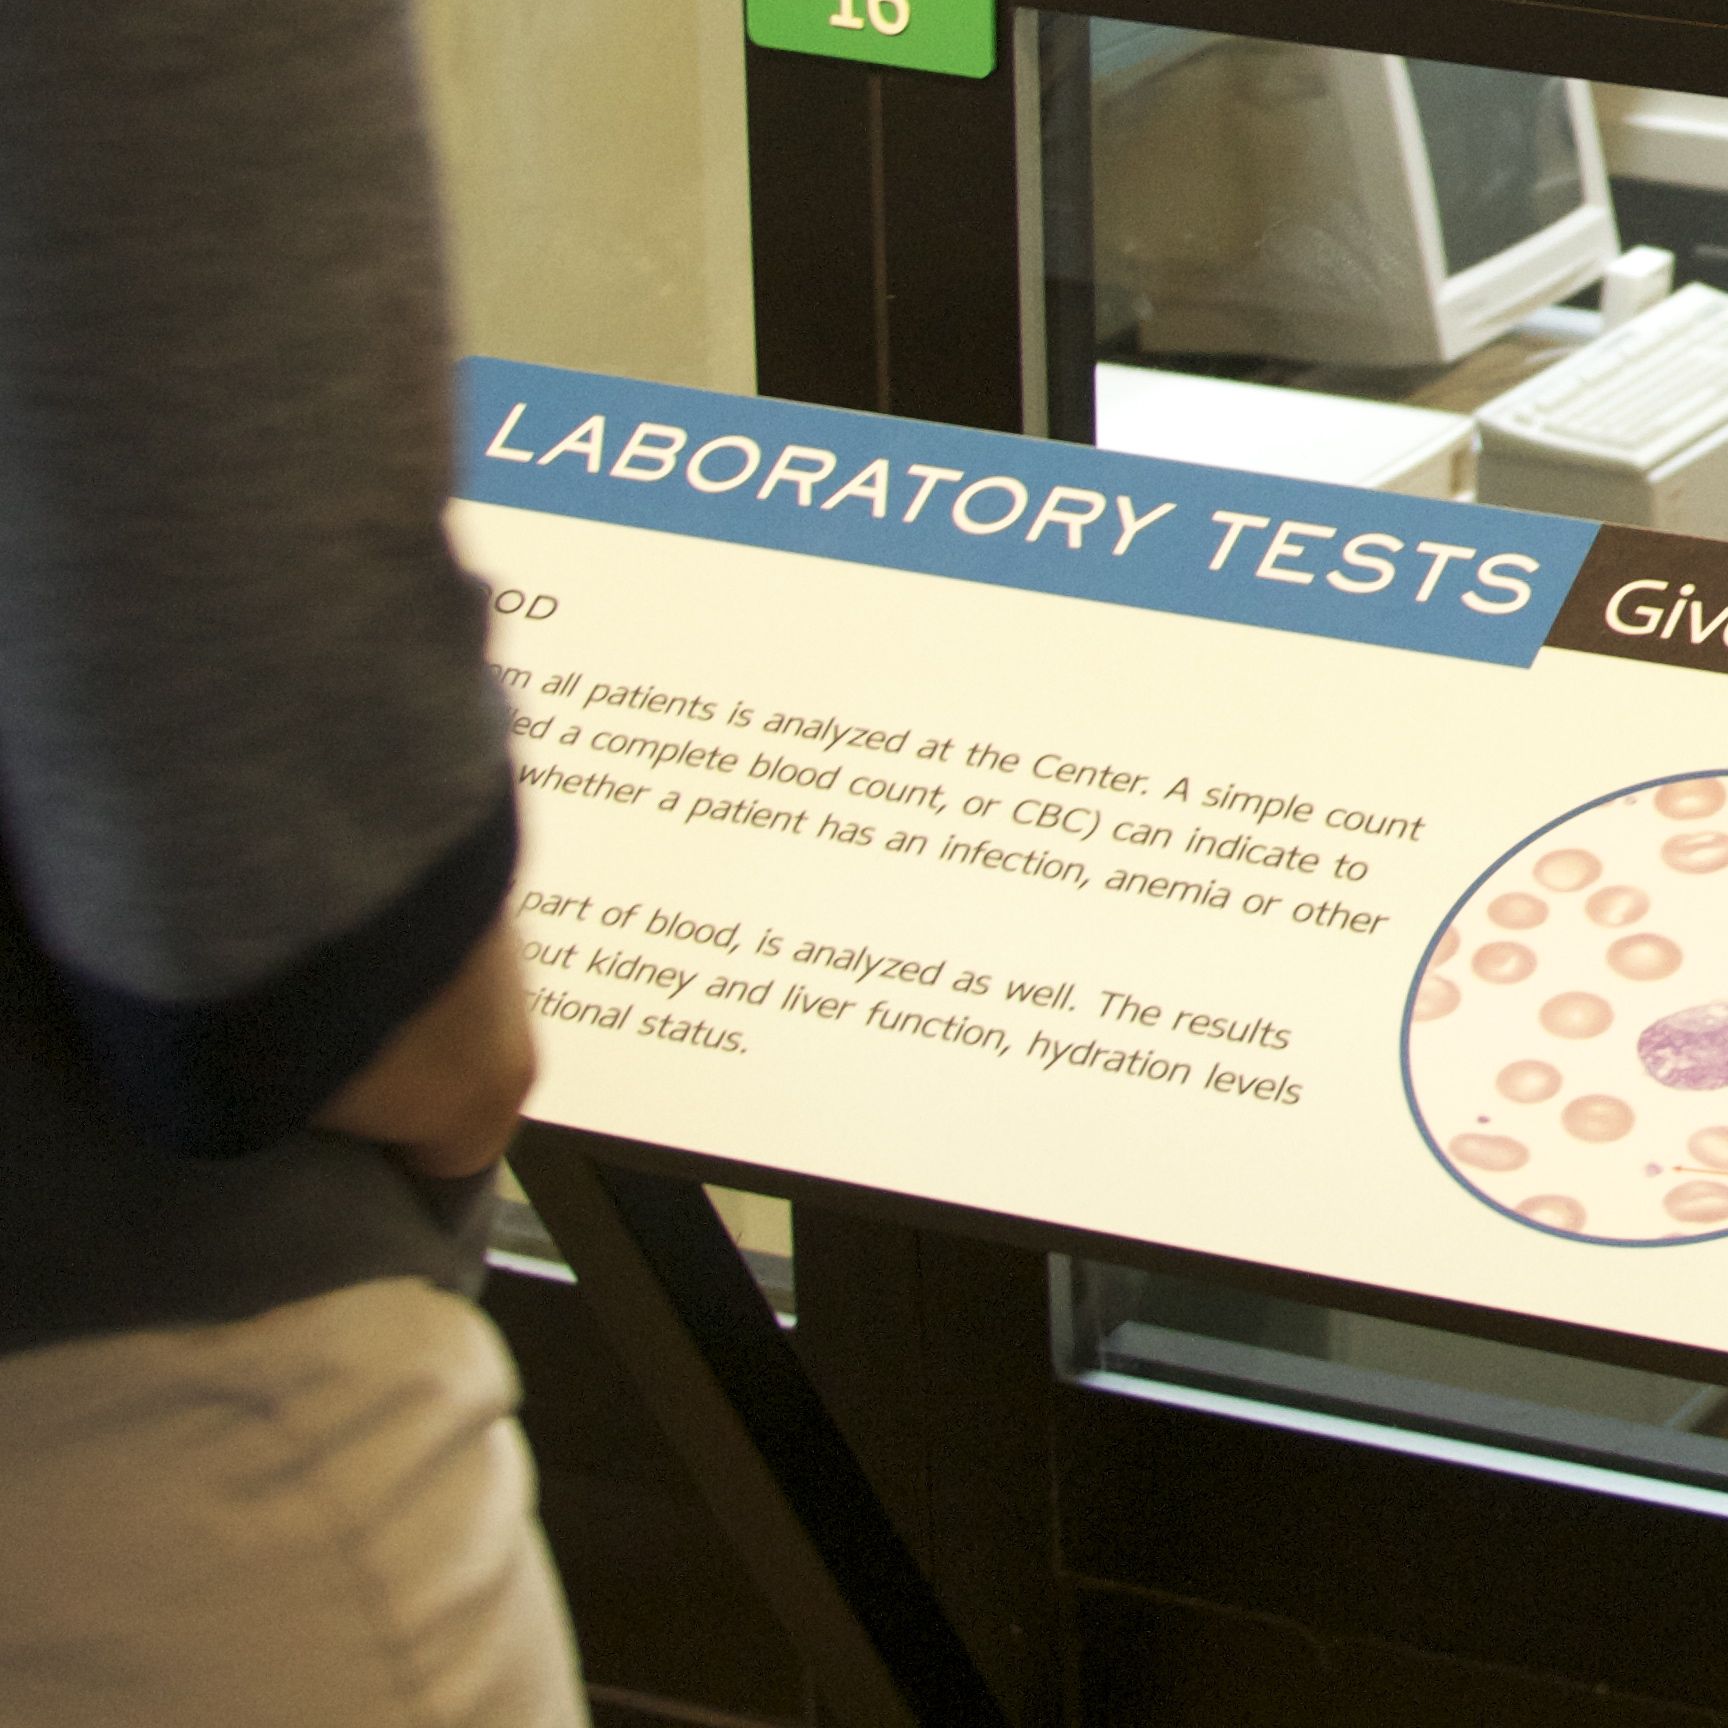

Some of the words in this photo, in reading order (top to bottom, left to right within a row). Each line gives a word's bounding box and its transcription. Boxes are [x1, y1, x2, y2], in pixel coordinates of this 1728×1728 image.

[486, 404, 1175, 555] LABORATORY
[1210, 511, 1539, 614] TESTS
[486, 583, 558, 620] OD
[540, 672, 583, 698] all
[581, 683, 718, 722] patients
[726, 700, 755, 728] is
[762, 712, 912, 754] analyzed
[915, 738, 955, 763] at
[965, 742, 1021, 774] the
[1031, 753, 1149, 796] Center.
[1163, 776, 1190, 803] A
[1201, 783, 1315, 826] simple
[1324, 808, 1426, 842] count
[558, 725, 582, 746] a
[590, 731, 739, 774] complete
[747, 752, 843, 791] blood
[848, 776, 947, 816] count,
[962, 795, 1002, 818] or
[1011, 798, 1102, 842] CBC)
[1112, 821, 1174, 849] can
[1184, 826, 1321, 874] indicate
[1333, 853, 1369, 882] to
[519, 763, 650, 806] whether
[657, 790, 682, 812] a
[684, 796, 809, 835] patient
[816, 812, 876, 847] has
[884, 830, 929, 856] an
[938, 834, 1090, 890] infection,
[1104, 869, 1232, 910] anemia
[1241, 893, 1283, 916] or
[1291, 900, 1390, 935] other
[517, 890, 594, 922] part
[600, 903, 643, 929] of
[644, 907, 741, 955] blood,
[755, 927, 784, 957] is
[792, 941, 947, 987] analyzed
[951, 970, 992, 996] as
[1005, 980, 1076, 1012] well.
[1099, 990, 1162, 1027] The
[1171, 1010, 1292, 1051] results
[522, 940, 579, 969] out
[585, 947, 699, 1000] kidney
[704, 975, 775, 1006] and
[780, 983, 857, 1021] liver
[865, 1000, 1011, 1058] function,
[1026, 1029, 1192, 1085] hydration
[1203, 1062, 1303, 1106] levels
[637, 1013, 747, 1055] status.
